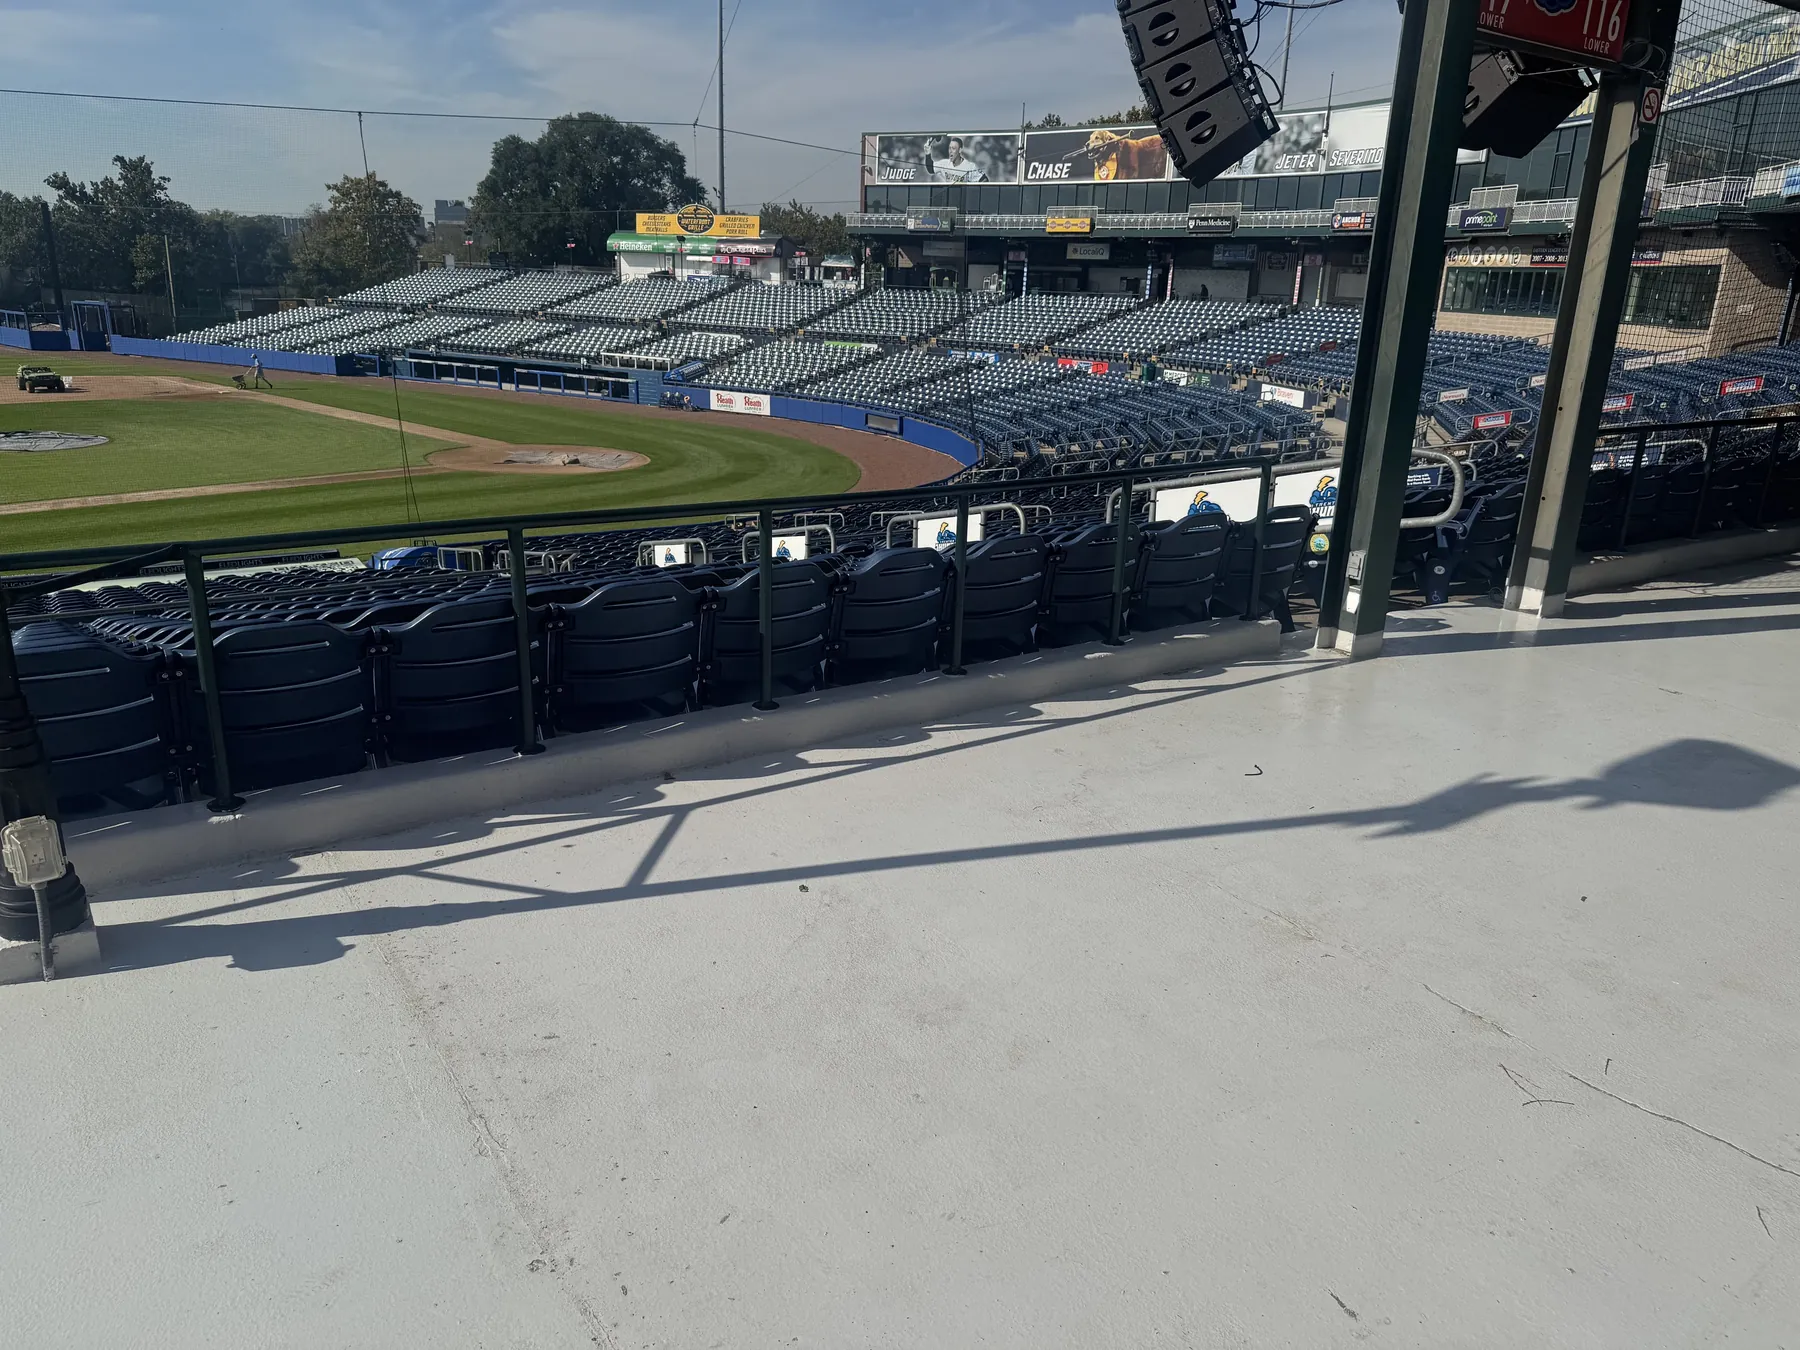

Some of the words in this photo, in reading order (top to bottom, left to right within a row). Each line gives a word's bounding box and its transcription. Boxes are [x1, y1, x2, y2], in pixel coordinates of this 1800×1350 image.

[1477, 12, 1505, 29] OWER
[1583, 0, 1622, 41] 116
[1584, 37, 1610, 54] LOWER
[1275, 153, 1317, 170] JETER
[1329, 147, 1384, 167] SEVERINO
[881, 166, 917, 180] JUDGE
[1027, 161, 1072, 180] CHASE
[1207, 218, 1231, 226] Medicine
[1464, 213, 1498, 227] primepoint
[620, 242, 652, 251] Heineken
